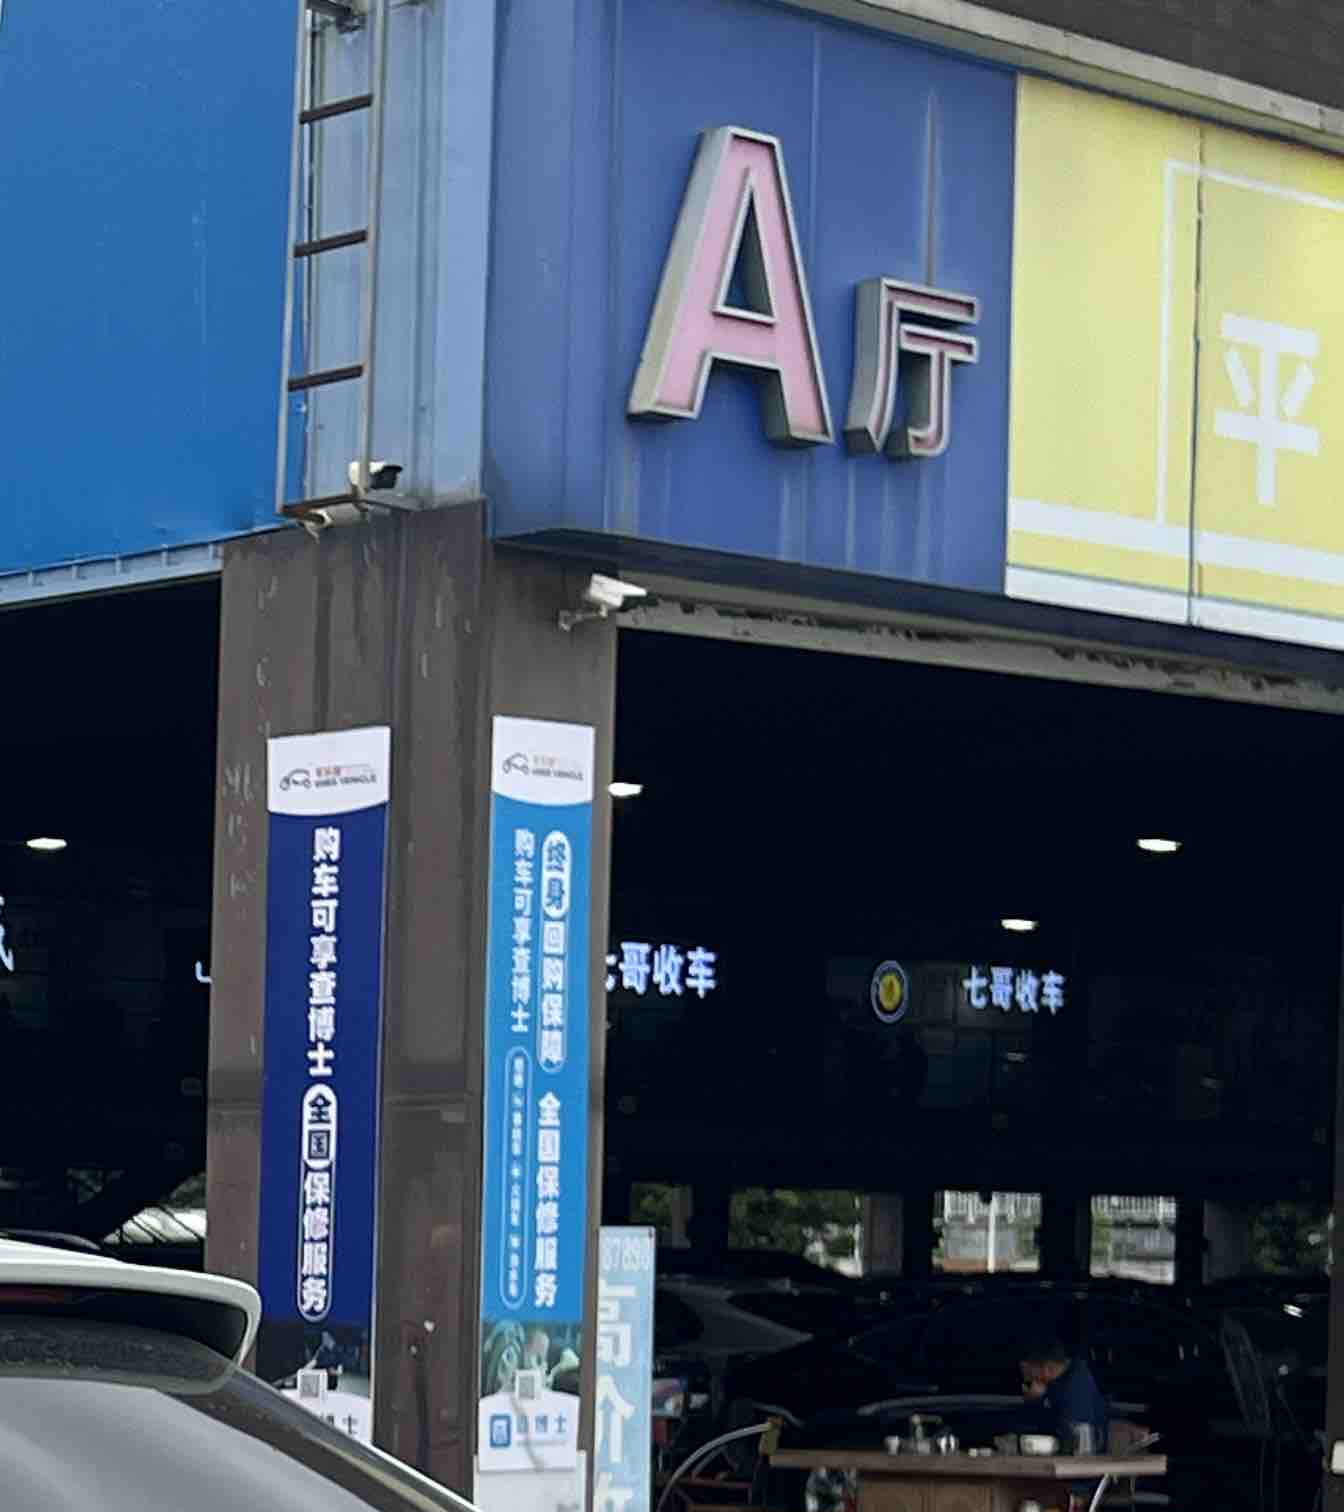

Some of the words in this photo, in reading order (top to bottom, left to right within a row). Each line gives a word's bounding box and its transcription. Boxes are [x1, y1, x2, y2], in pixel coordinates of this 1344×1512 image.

[1214, 312, 1321, 507] 平
[308, 827, 341, 1077] 购车可享查博士
[963, 965, 1065, 1015] 七哥收车
[301, 1093, 333, 1313] 全国保修服务
